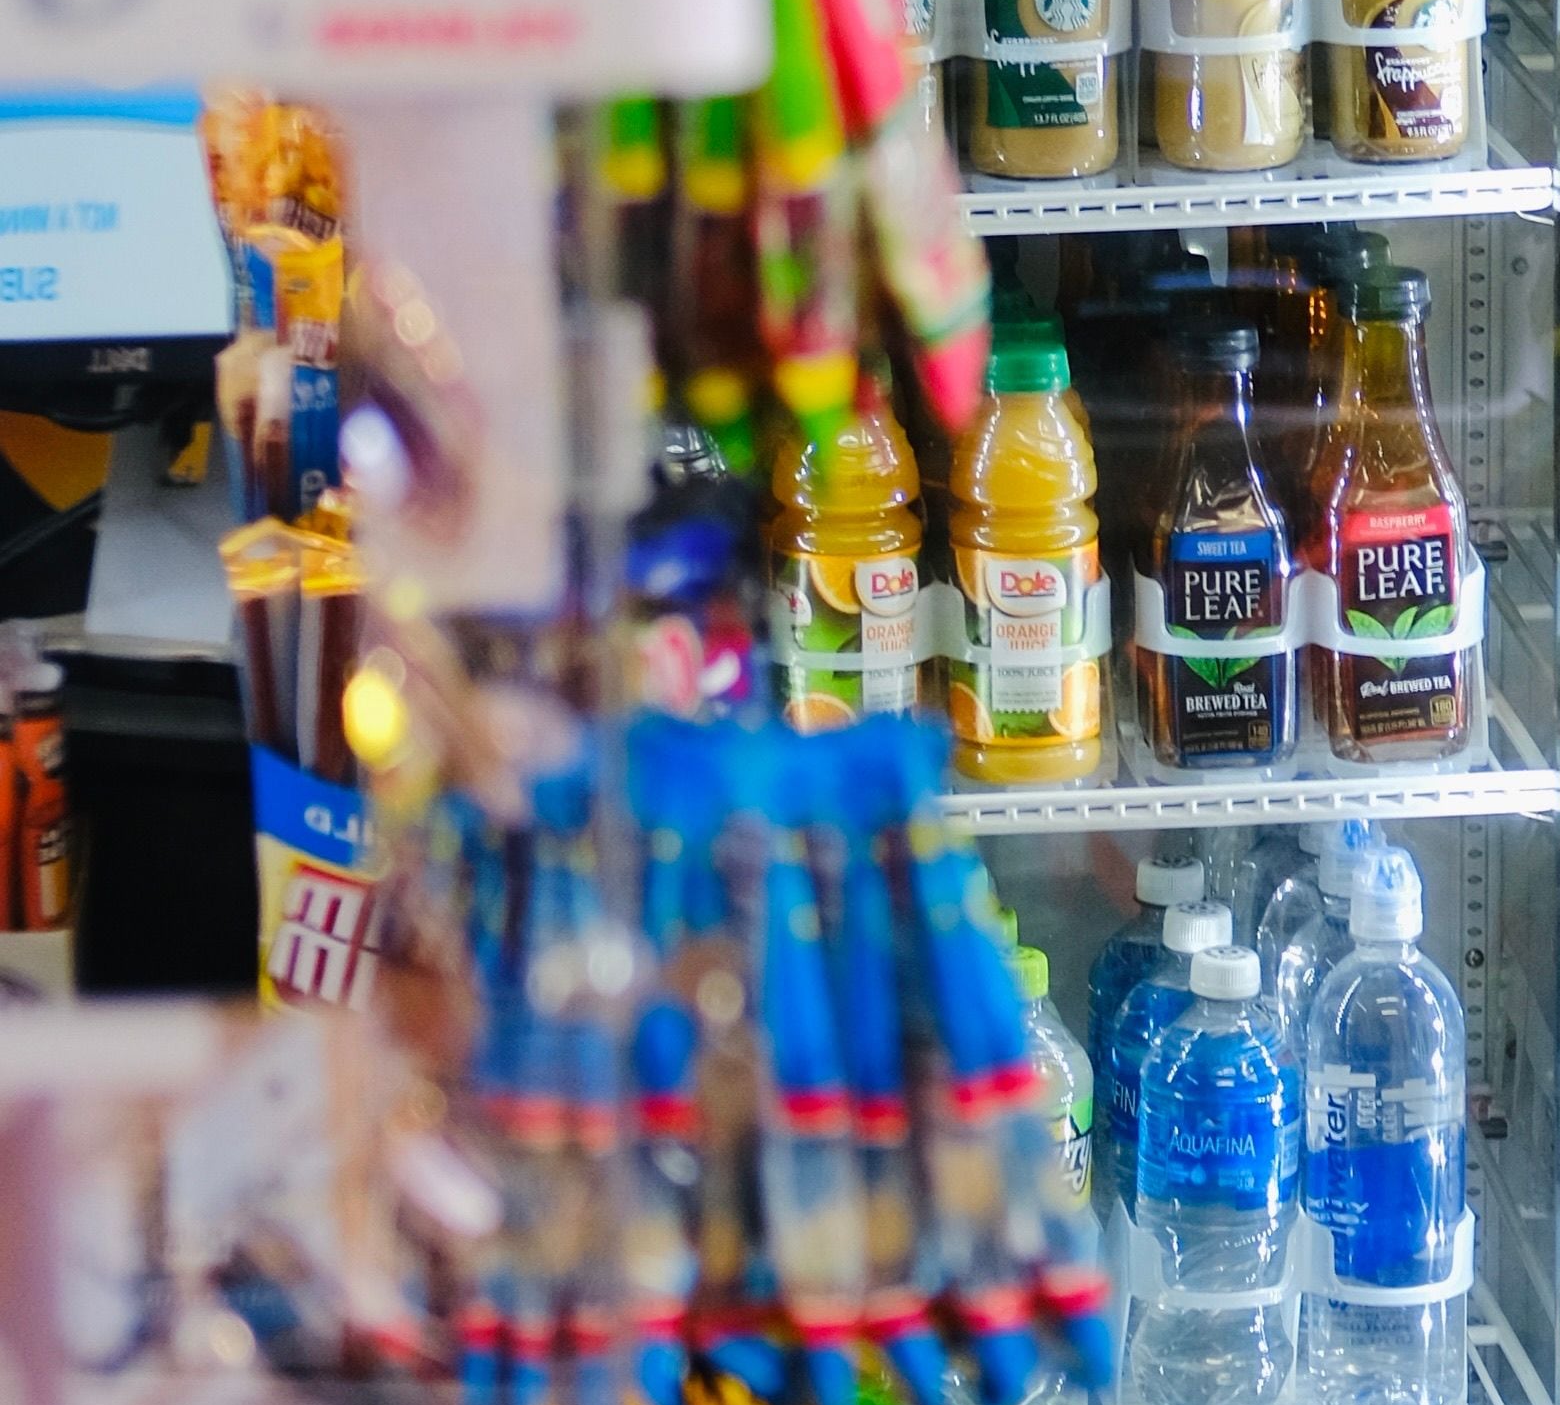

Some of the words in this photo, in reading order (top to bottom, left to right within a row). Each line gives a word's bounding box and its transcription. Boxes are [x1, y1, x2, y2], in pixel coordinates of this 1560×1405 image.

[1369, 513, 1427, 529] RASPBERRY
[1197, 541, 1227, 557] SWEET
[1229, 542, 1248, 556] TEA
[1356, 541, 1444, 575] PURE
[871, 568, 914, 594] Dole
[1000, 569, 1057, 594] Dole
[1184, 569, 1261, 596] PURE
[995, 622, 1057, 640] ORANGE
[1390, 677, 1432, 695] BREWED
[1433, 674, 1453, 690] TEA
[1185, 693, 1241, 714] BREWED
[1243, 693, 1268, 711] TEA
[1168, 1131, 1257, 1159] AQUAFINA
